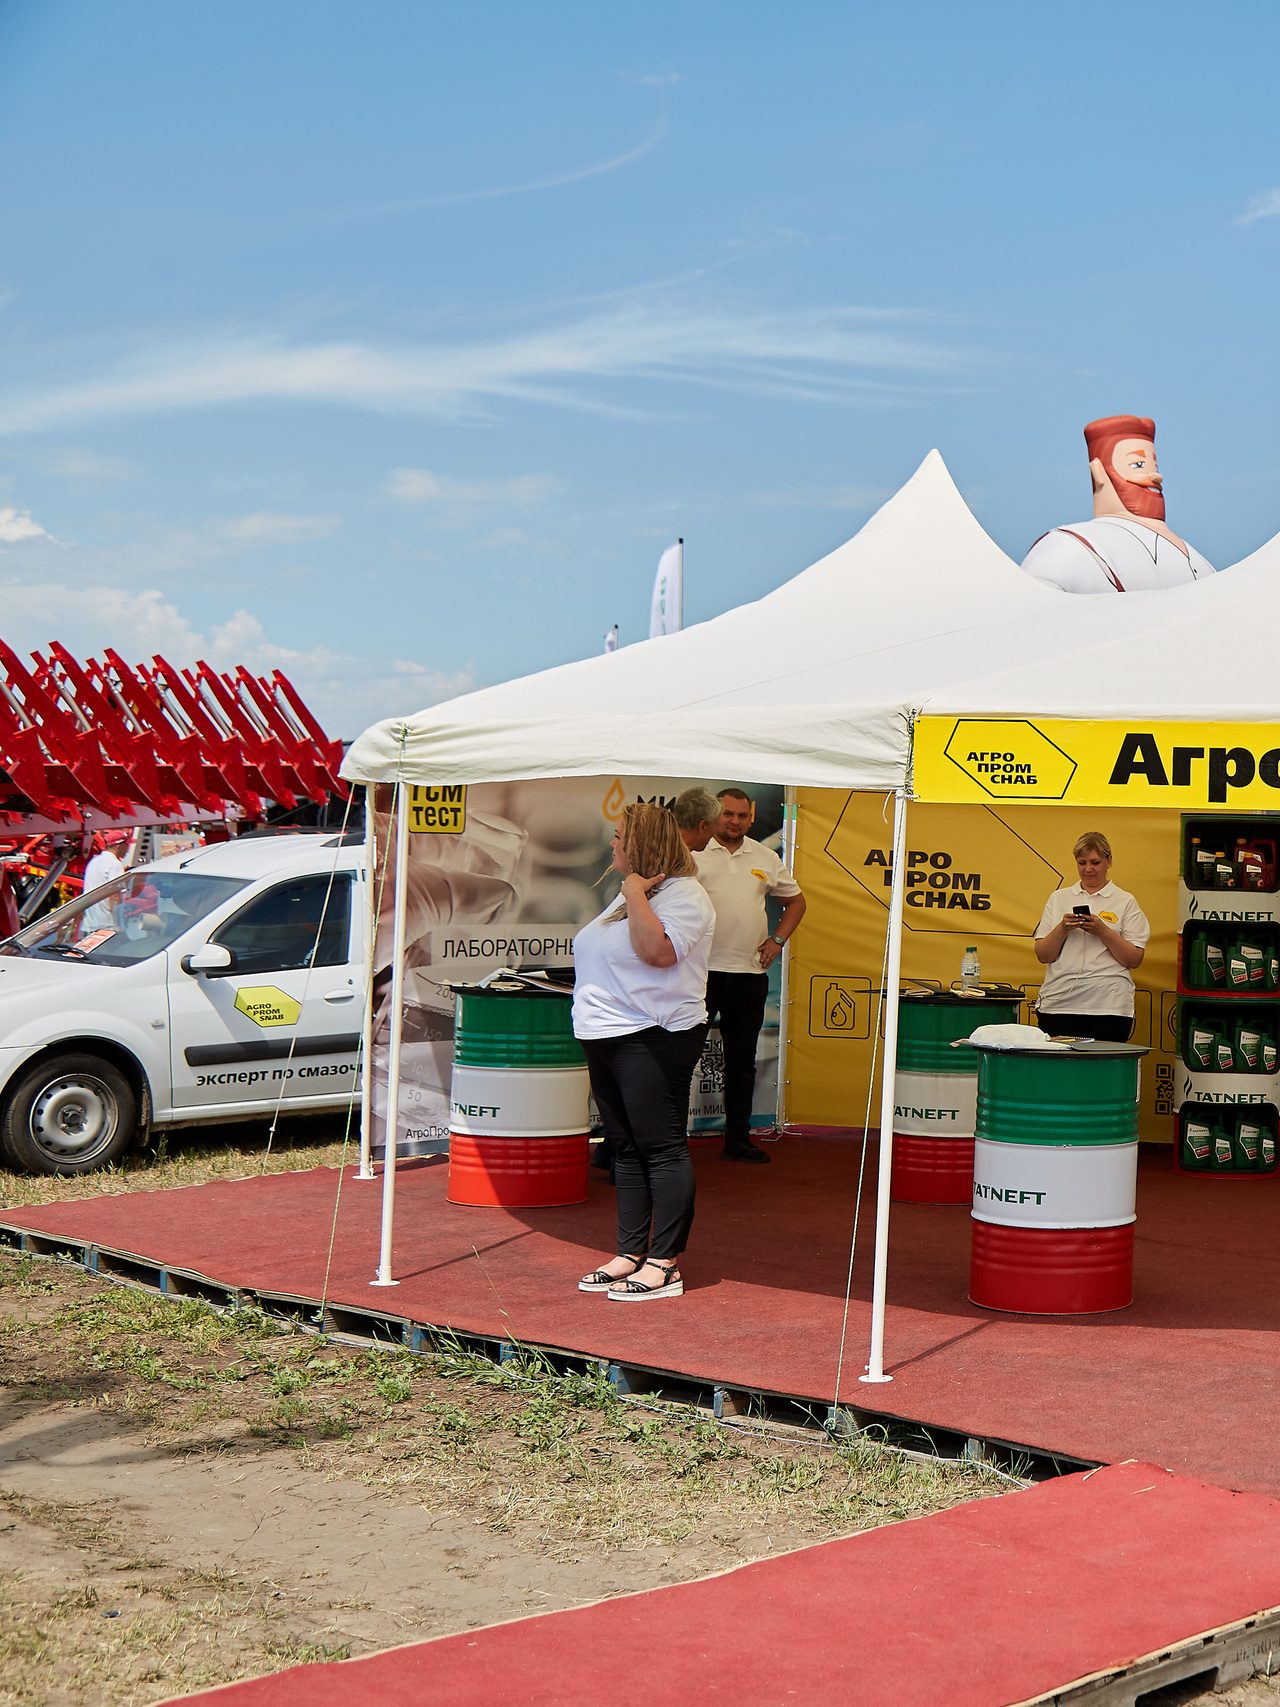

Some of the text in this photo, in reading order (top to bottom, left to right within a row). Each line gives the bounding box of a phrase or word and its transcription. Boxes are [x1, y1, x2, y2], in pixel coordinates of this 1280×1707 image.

[966, 752, 1015, 762] АГРО
[977, 763, 1032, 773] ПРОМ
[990, 774, 1038, 785] СНАБ
[412, 806, 461, 827] тест
[906, 891, 992, 911] СНАБ
[1200, 910, 1274, 921] TATNEFT
[246, 1003, 272, 1011] AGRO
[252, 1008, 281, 1016] PROM
[423, 1026, 443, 1042] 150
[196, 1069, 269, 1086] эксперт
[272, 1067, 295, 1080] по
[411, 1062, 431, 1078] 100
[407, 1089, 422, 1102] 50
[1194, 1091, 1267, 1104] TATNEFT
[450, 1102, 500, 1118] ATNEFT
[893, 1105, 960, 1120] ATNEFT
[405, 1125, 450, 1141] АгроПро
[973, 1181, 1047, 1205] TATNEFT
